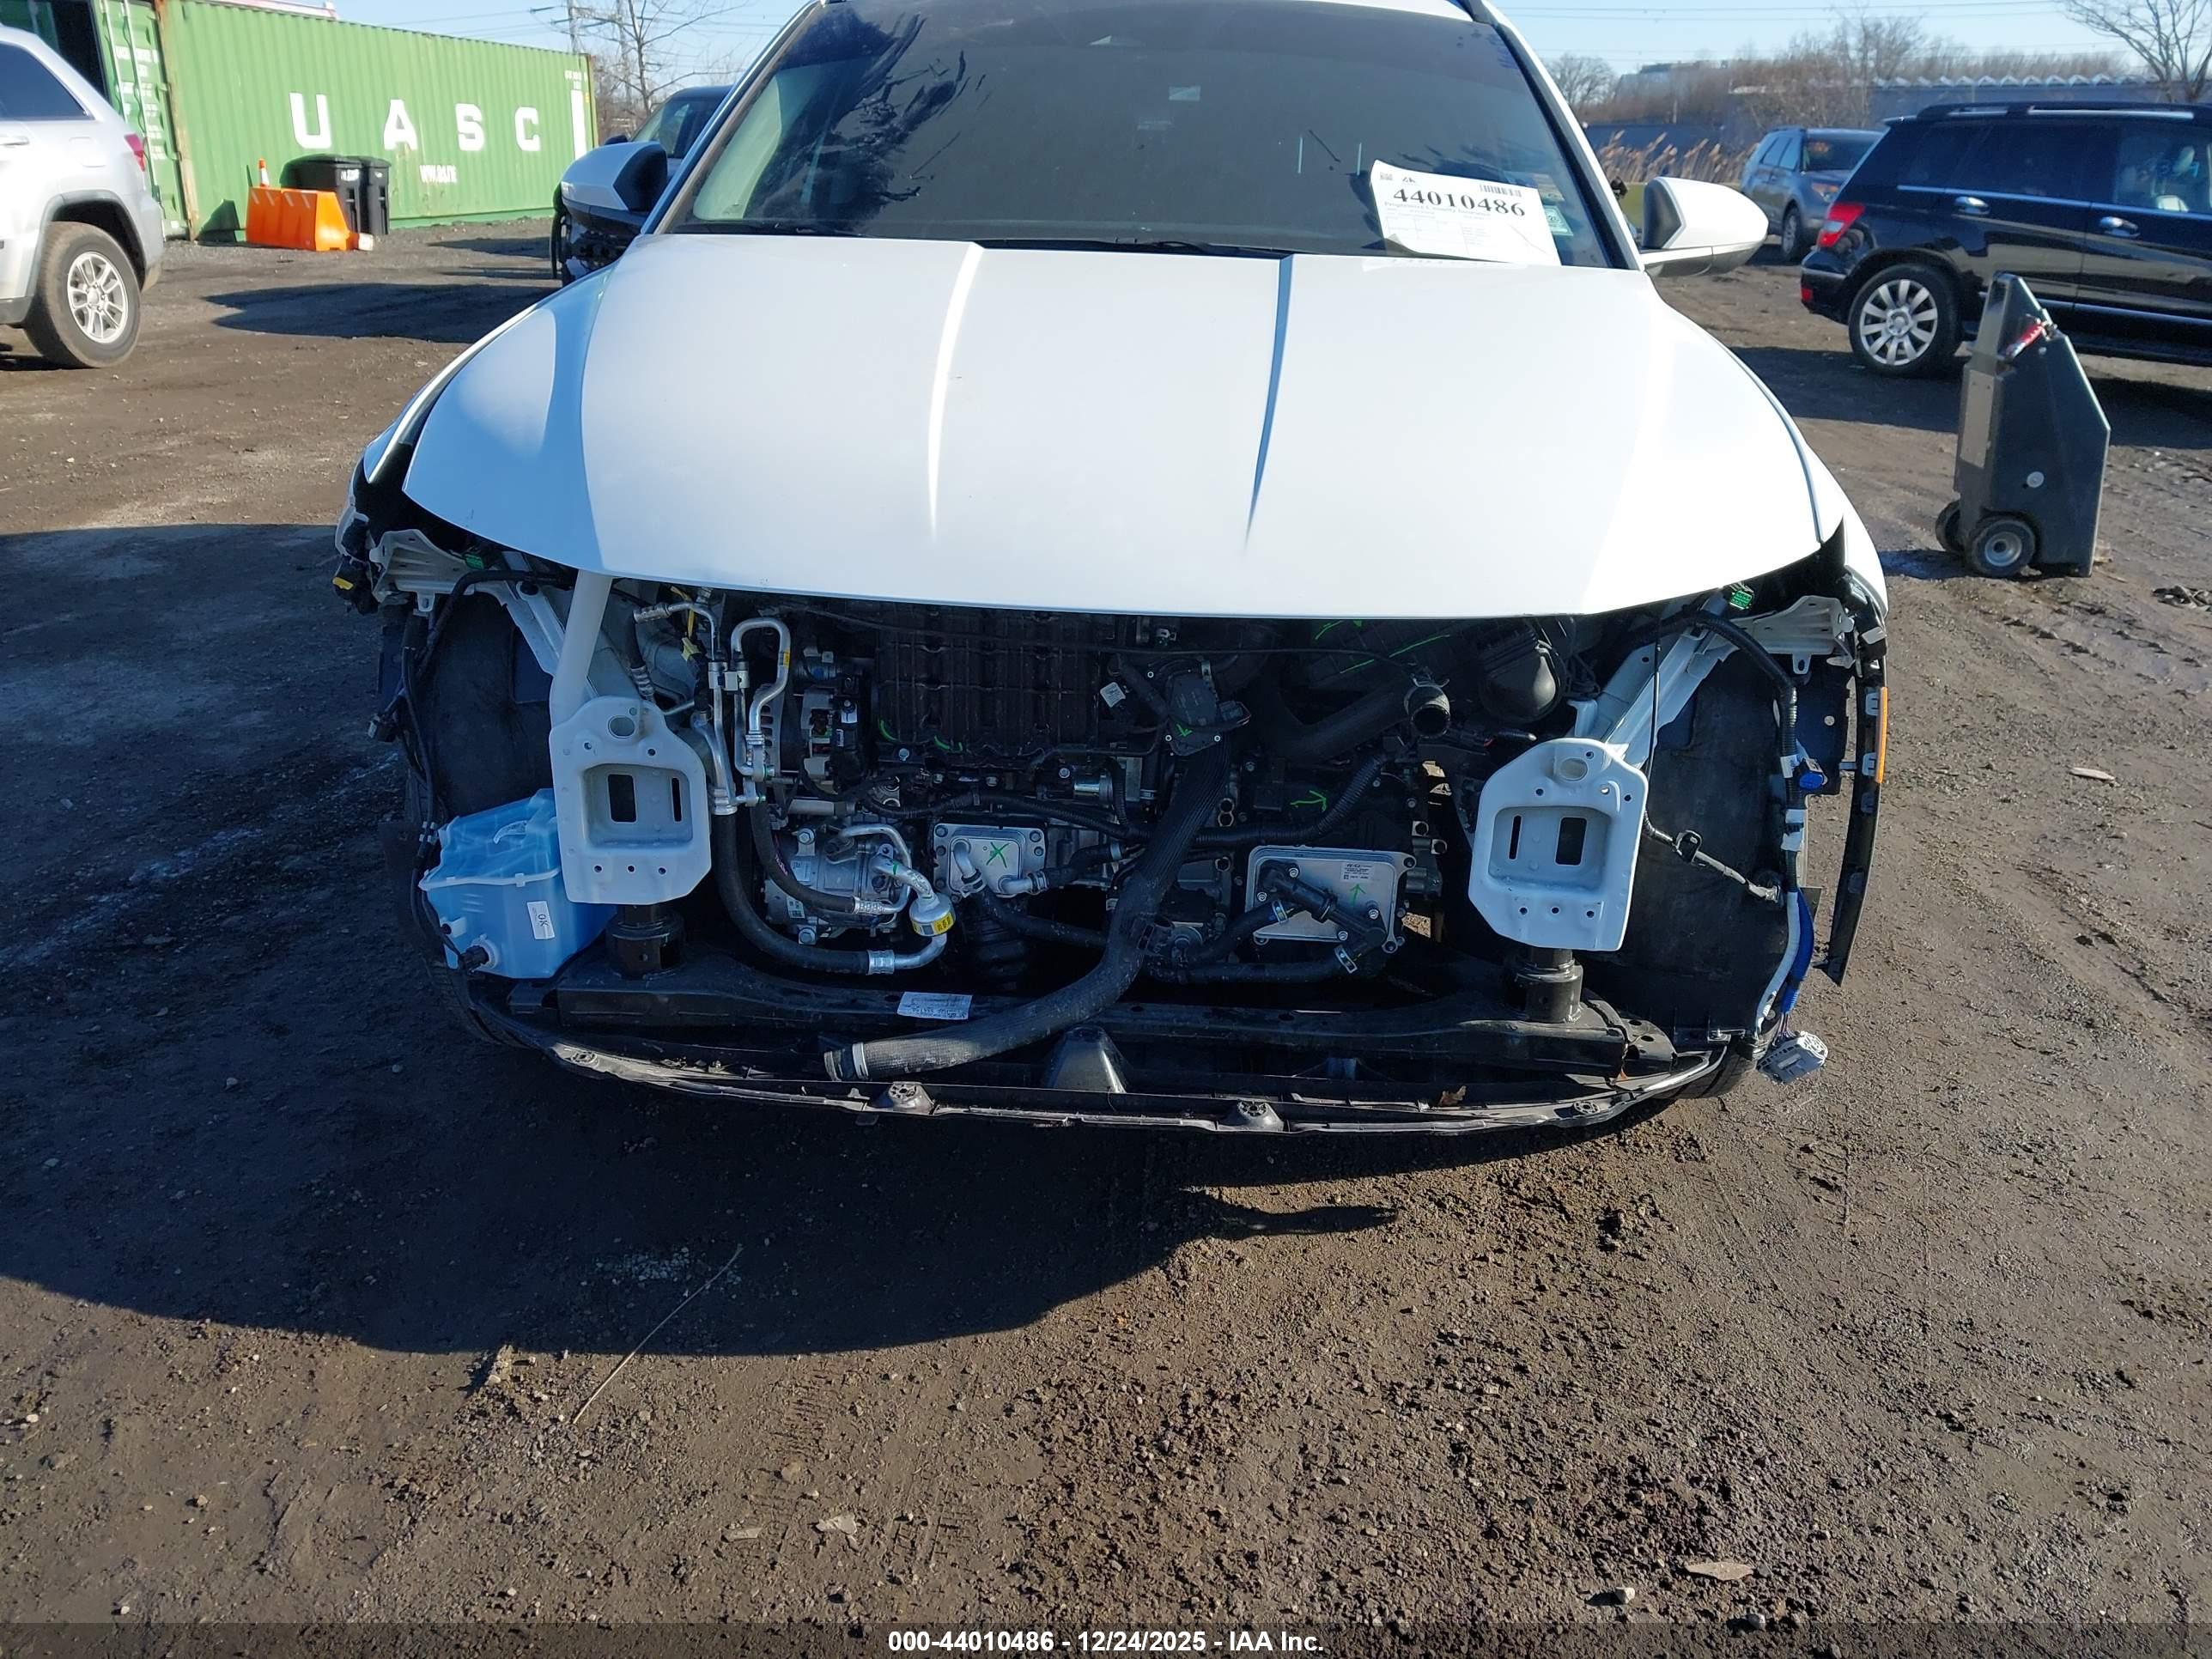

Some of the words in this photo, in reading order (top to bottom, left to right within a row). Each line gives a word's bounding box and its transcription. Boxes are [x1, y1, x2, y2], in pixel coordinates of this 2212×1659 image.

[289, 92, 541, 152] UASC
[1393, 187, 1526, 217] 44010486
[538, 915, 549, 927] OK
